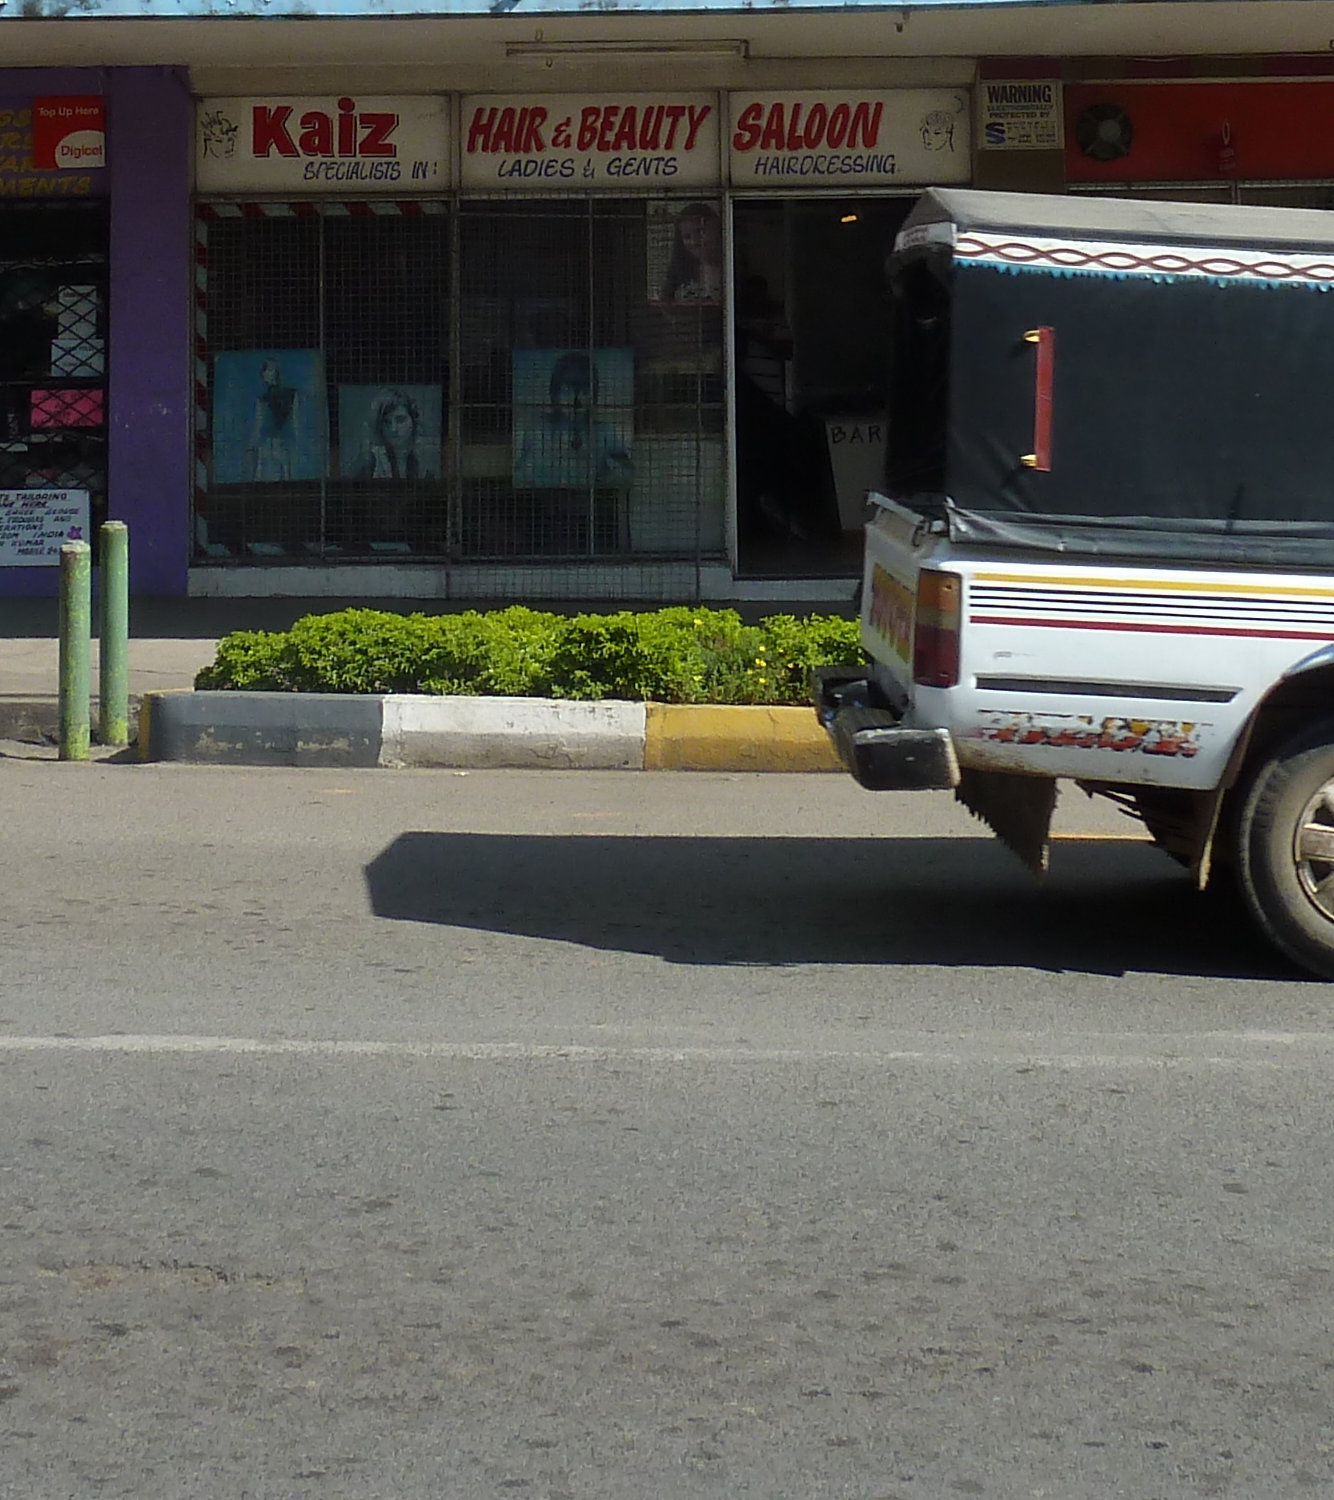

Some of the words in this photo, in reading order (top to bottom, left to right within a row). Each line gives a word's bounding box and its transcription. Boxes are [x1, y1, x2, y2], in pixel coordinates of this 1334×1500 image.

[986, 84, 1052, 104] WARNING
[37, 106, 56, 118] Top
[58, 106, 73, 118] Up
[75, 105, 100, 116] Here
[989, 111, 1037, 119] PROTECTED
[252, 97, 399, 158] Kaiz
[467, 106, 548, 153] HAIR
[551, 116, 572, 149] &
[575, 105, 713, 152] BEAUTY
[732, 102, 884, 152] SALOON
[60, 144, 104, 159] Digicel
[303, 161, 402, 181] SPECIALISTS
[497, 158, 576, 179] LADIES
[583, 158, 595, 179] &
[605, 157, 679, 177] GENTS
